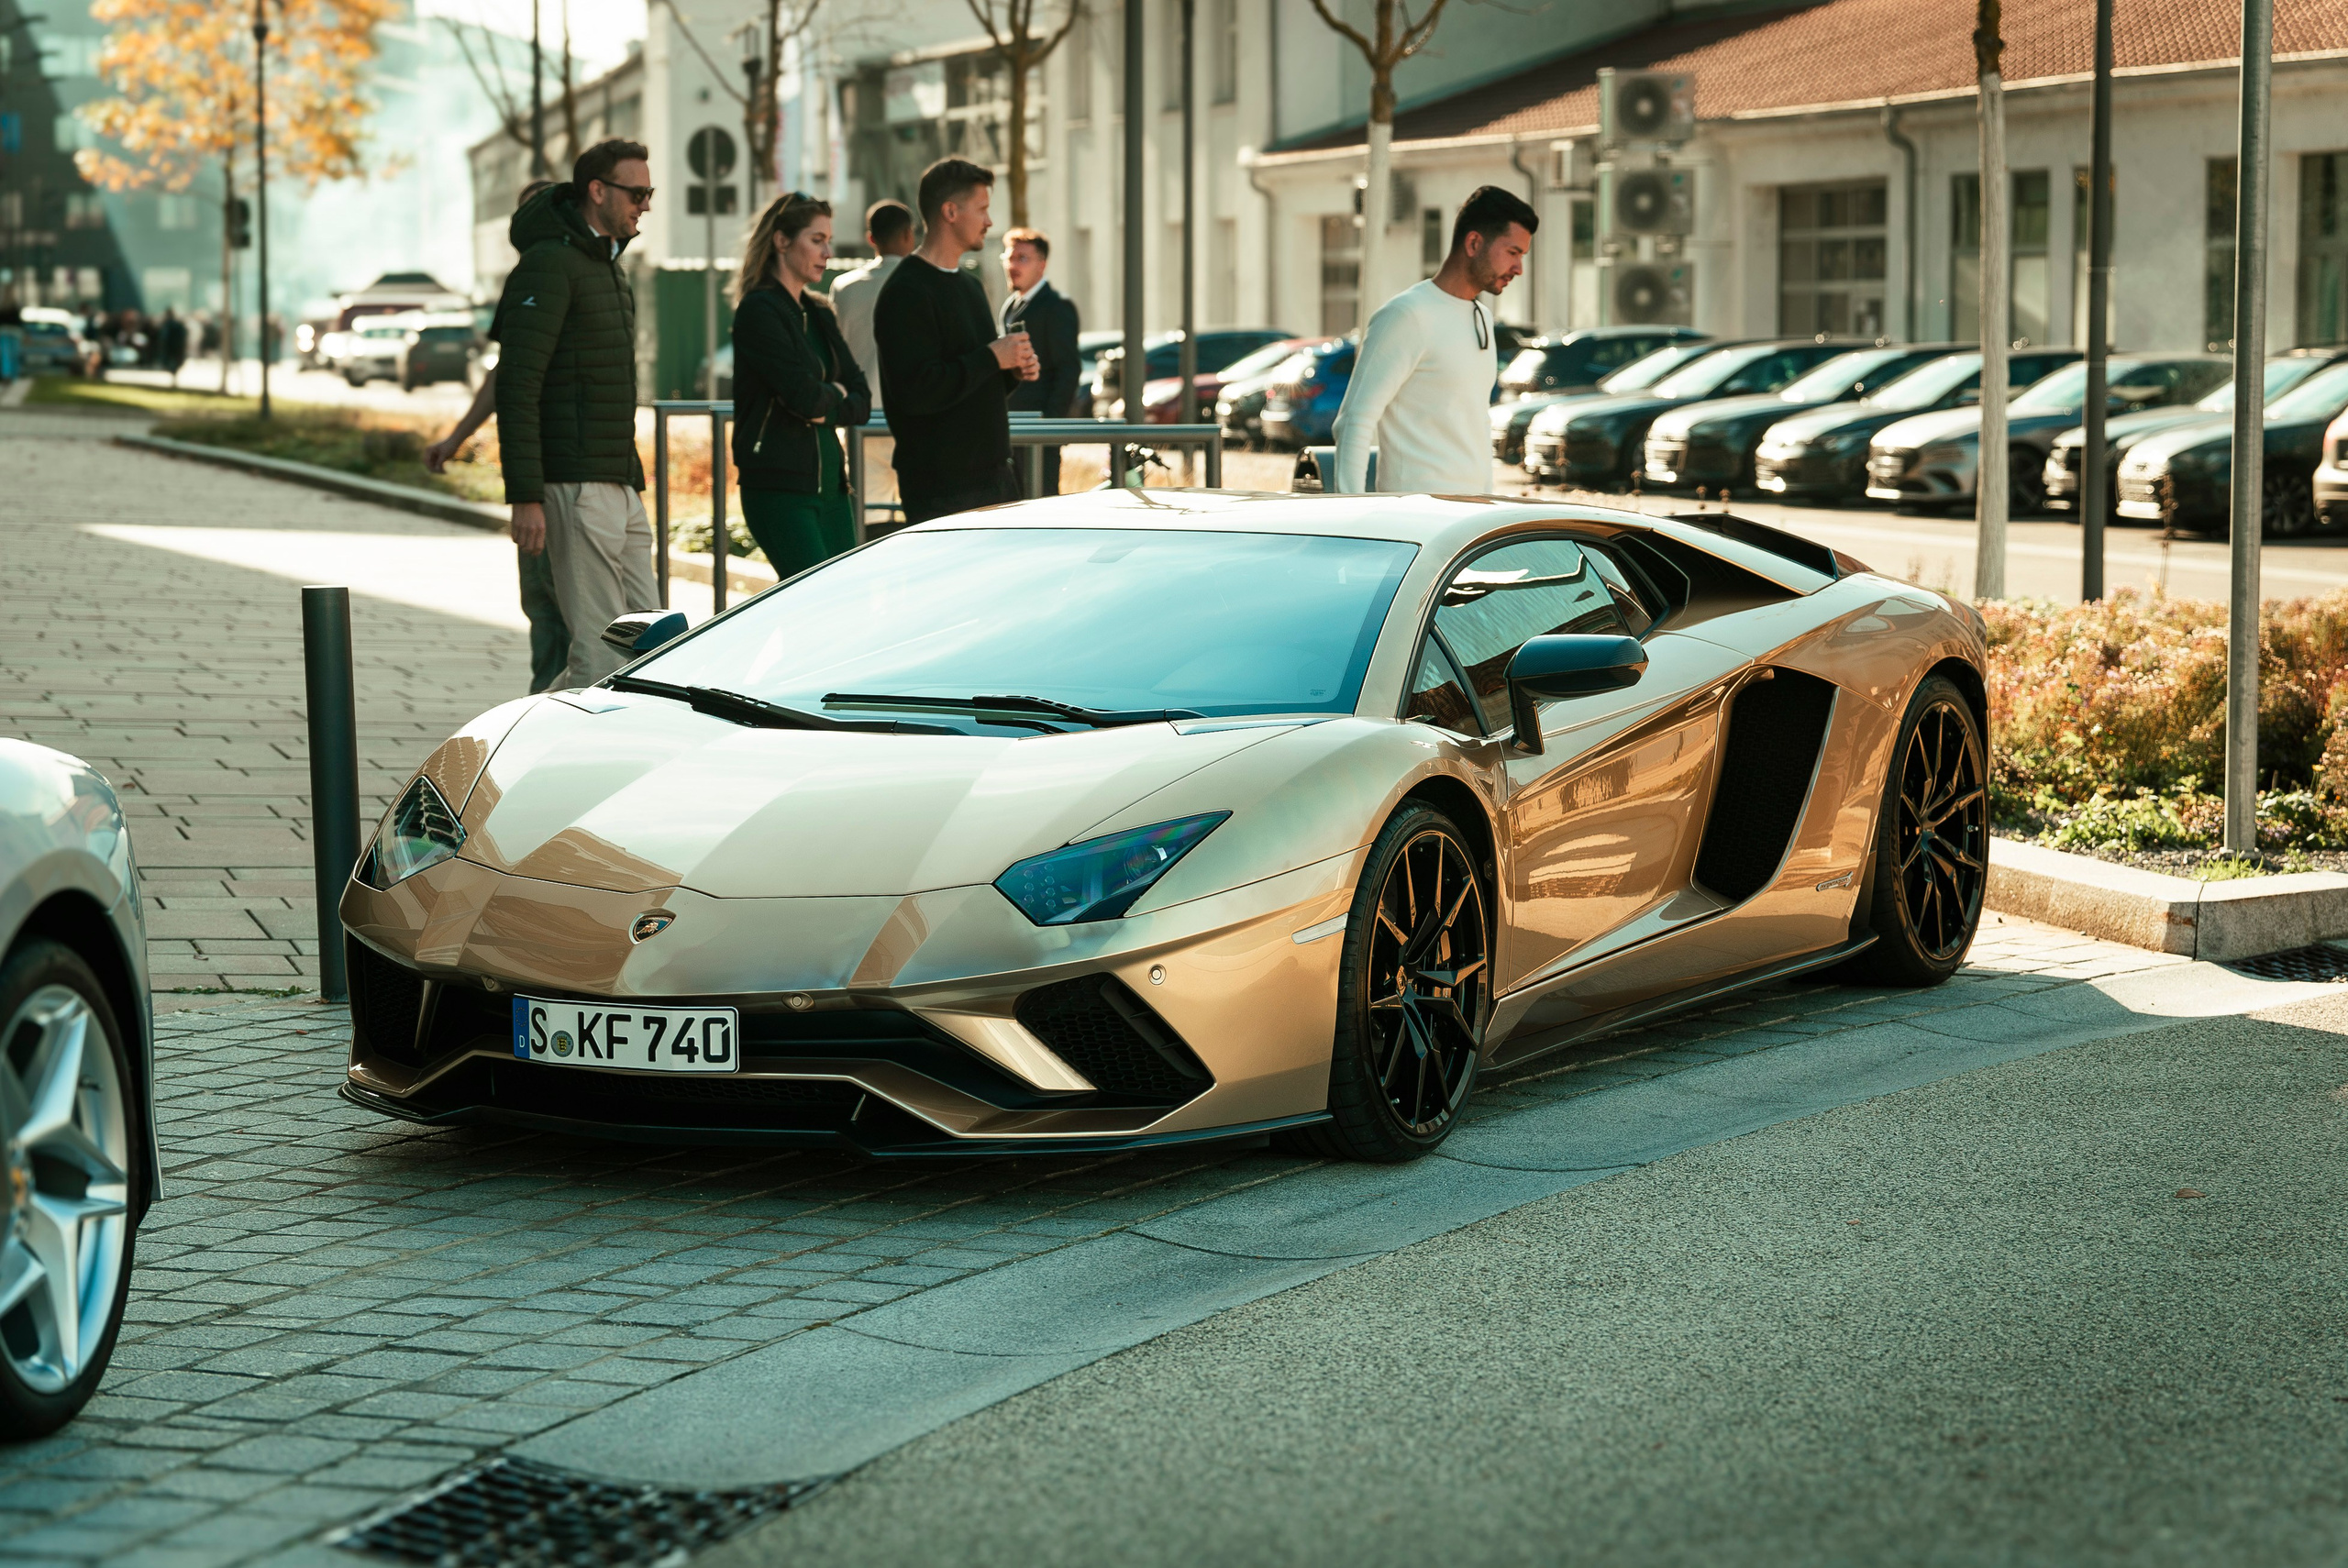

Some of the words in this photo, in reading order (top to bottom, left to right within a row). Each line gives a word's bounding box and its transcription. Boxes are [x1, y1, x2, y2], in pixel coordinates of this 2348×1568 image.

[519, 1034, 526, 1048] D
[531, 1007, 548, 1055] S
[578, 1011, 631, 1059] KF
[643, 1016, 730, 1064] 740
